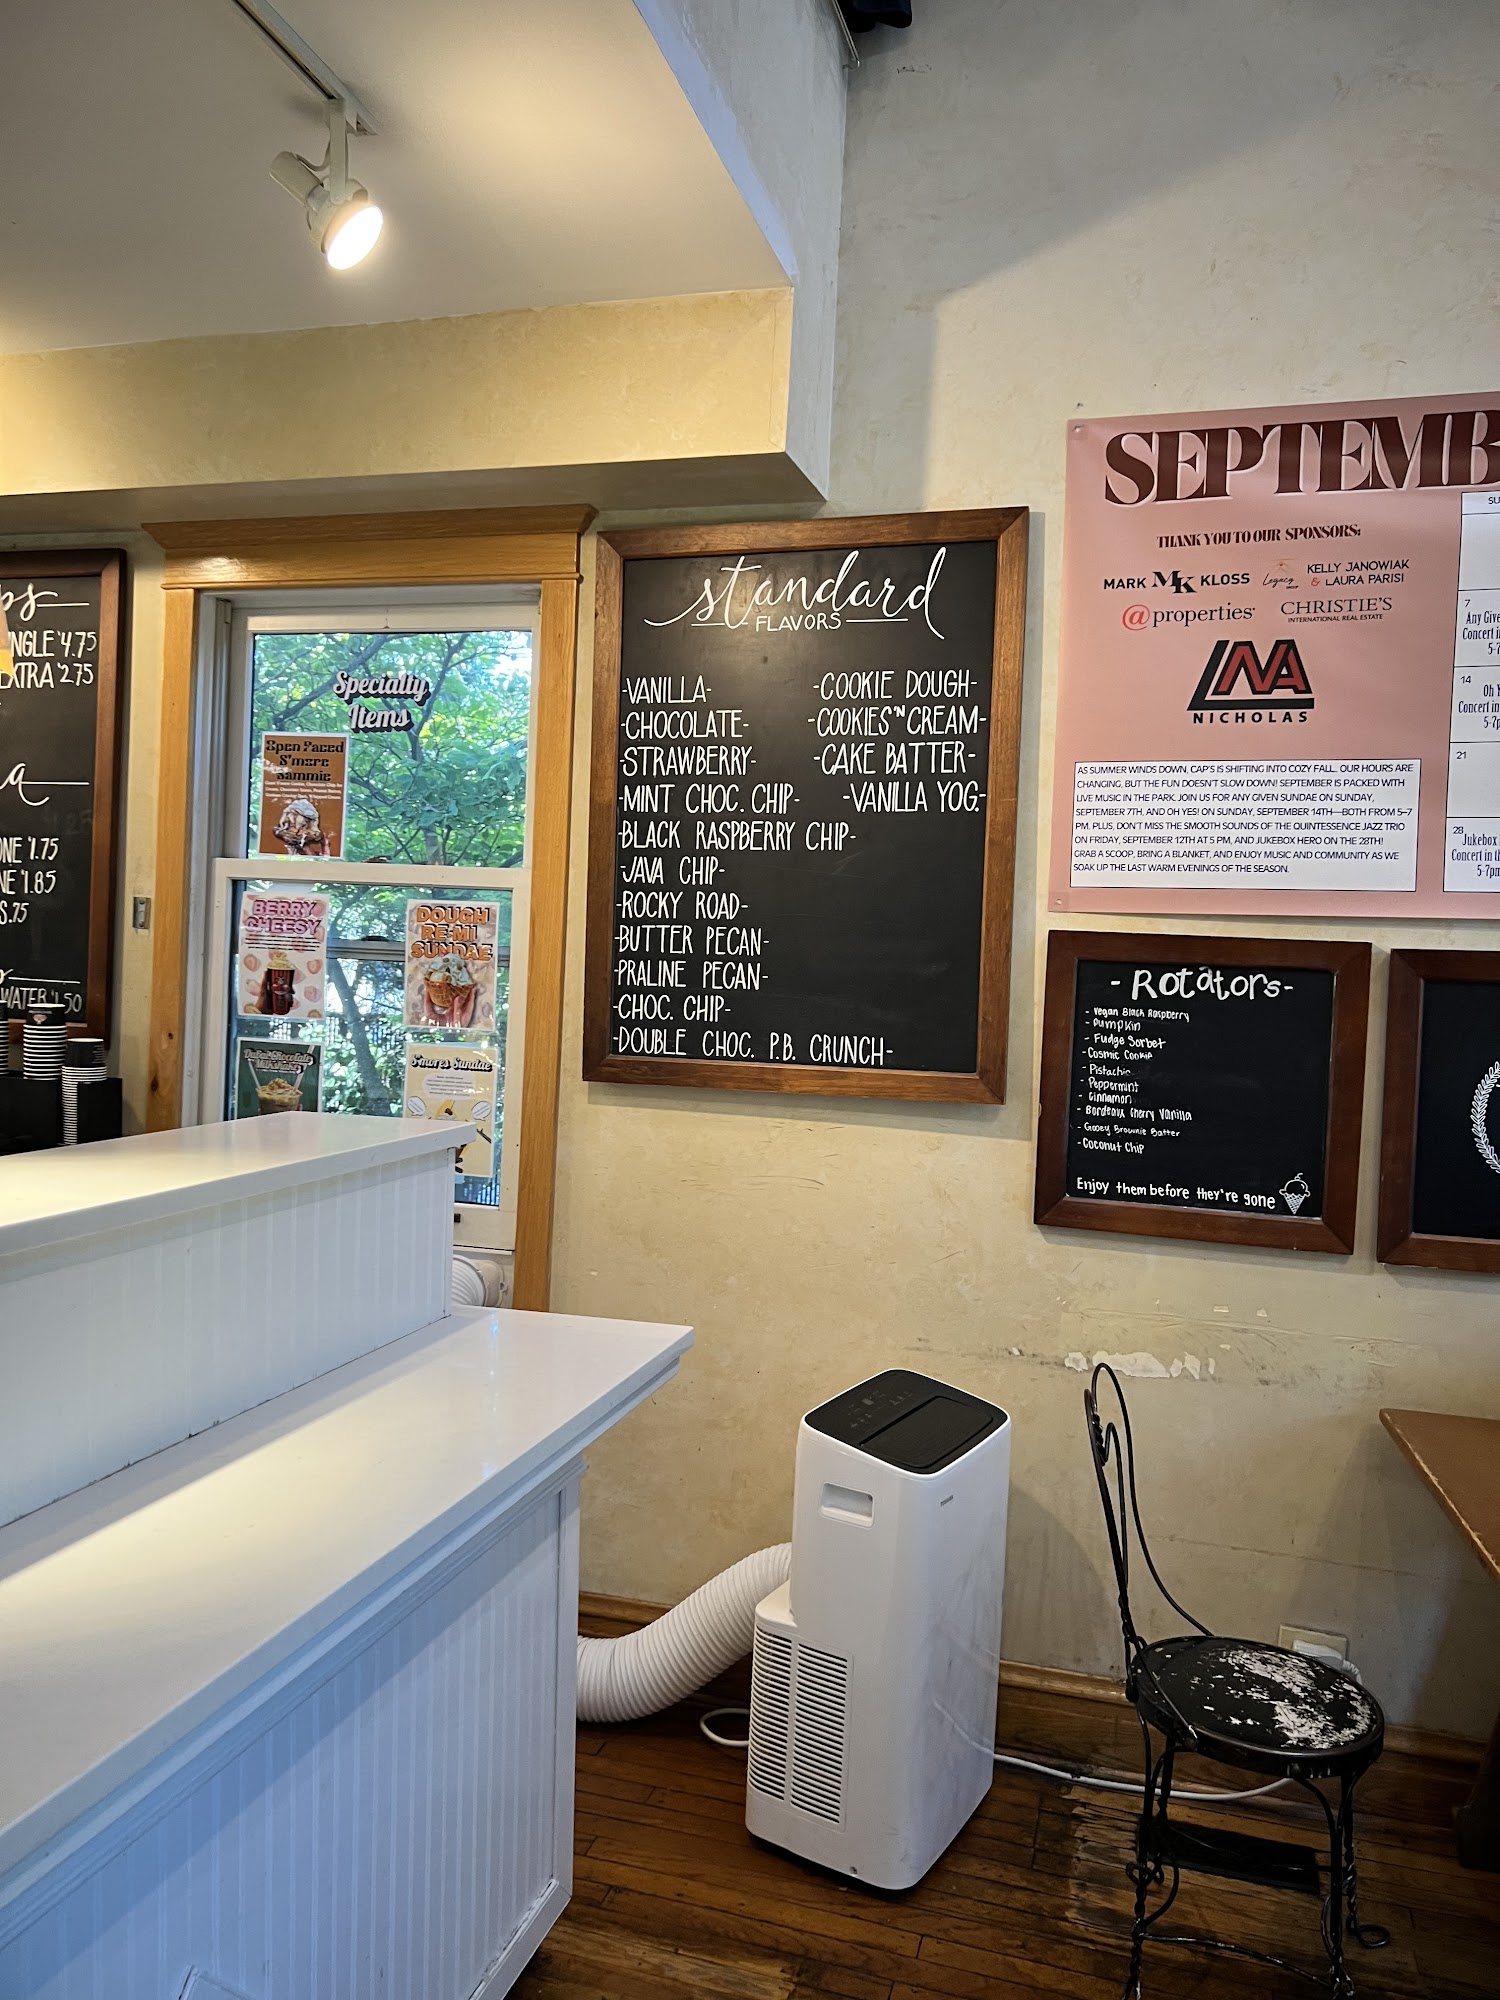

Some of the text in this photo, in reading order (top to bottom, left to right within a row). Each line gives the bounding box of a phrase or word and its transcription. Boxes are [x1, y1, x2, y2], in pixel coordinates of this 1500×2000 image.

[1156, 524, 1361, 548] THANK YOU TO OUR SPONSORS:
[1307, 559, 1410, 574] KELLY JANOWIAK
[1103, 577, 1147, 590] MARK
[1200, 573, 1251, 586] KLOSS
[1311, 573, 1404, 586] & LAURA PARISI
[644, 546, 946, 640] standard
[1280, 597, 1392, 615] CHRISTIE'S
[1464, 599, 1471, 608] 7
[755, 612, 842, 632] FLAVORS
[1466, 611, 1482, 626] Any
[1462, 628, 1494, 640] Concert
[8, 630, 54, 658] NGLE
[333, 670, 431, 705] Specialty
[1460, 676, 1472, 684] 14
[1483, 684, 1494, 697] Oh
[1458, 700, 1490, 714] Concert
[348, 704, 413, 733] Items
[1193, 711, 1308, 724] NICHOLAS
[1456, 751, 1466, 760] 21
[277, 770, 330, 782] Sammie
[1078, 764, 1414, 774] AS SUMMER WINDS DOWN, CAP'S IS SHIFTING INTO COZY FALL. OUR HOURS ARE
[1077, 779, 1405, 788] CHANGING, BUT THE FUN DOESN'T SLOW DOWN! SEPTEMBER IS PACKED WITH
[686, 782, 745, 814] CHOC.
[695, 820, 796, 852] RASPBERRY
[1452, 826, 1464, 834] 28
[1462, 833, 1497, 846] Jukebox
[1452, 849, 1492, 862] Concert in
[1074, 864, 1290, 873] SOAK UP THE LAST WARM EVENINGS OF THE SEASON.
[252, 900, 317, 917] BERRY
[416, 906, 490, 925] DOUGH
[245, 916, 322, 935] CHEESY
[411, 940, 493, 960] SUNDAE
[1094, 1007, 1118, 1018] Vegan
[1148, 1008, 1190, 1023] Raspberry
[702, 1030, 754, 1058] CHOC.
[769, 1032, 796, 1062] P.B.
[1093, 1033, 1166, 1049] Fudge Sorbet
[1124, 1050, 1153, 1060] Cookie
[412, 1054, 492, 1072] S'mores Sundae
[1090, 1064, 1132, 1076] Pistachio
[1088, 1076, 1140, 1092] Peppermint
[1088, 1092, 1132, 1104] Cinnamon
[1086, 1105, 1192, 1122] Bordeaux Cherry Vanilla
[1084, 1122, 1180, 1137] Gooey Brownie Batter
[1124, 1142, 1145, 1154] Chip
[1077, 1176, 1276, 1210] Enjoy them before they're gone
